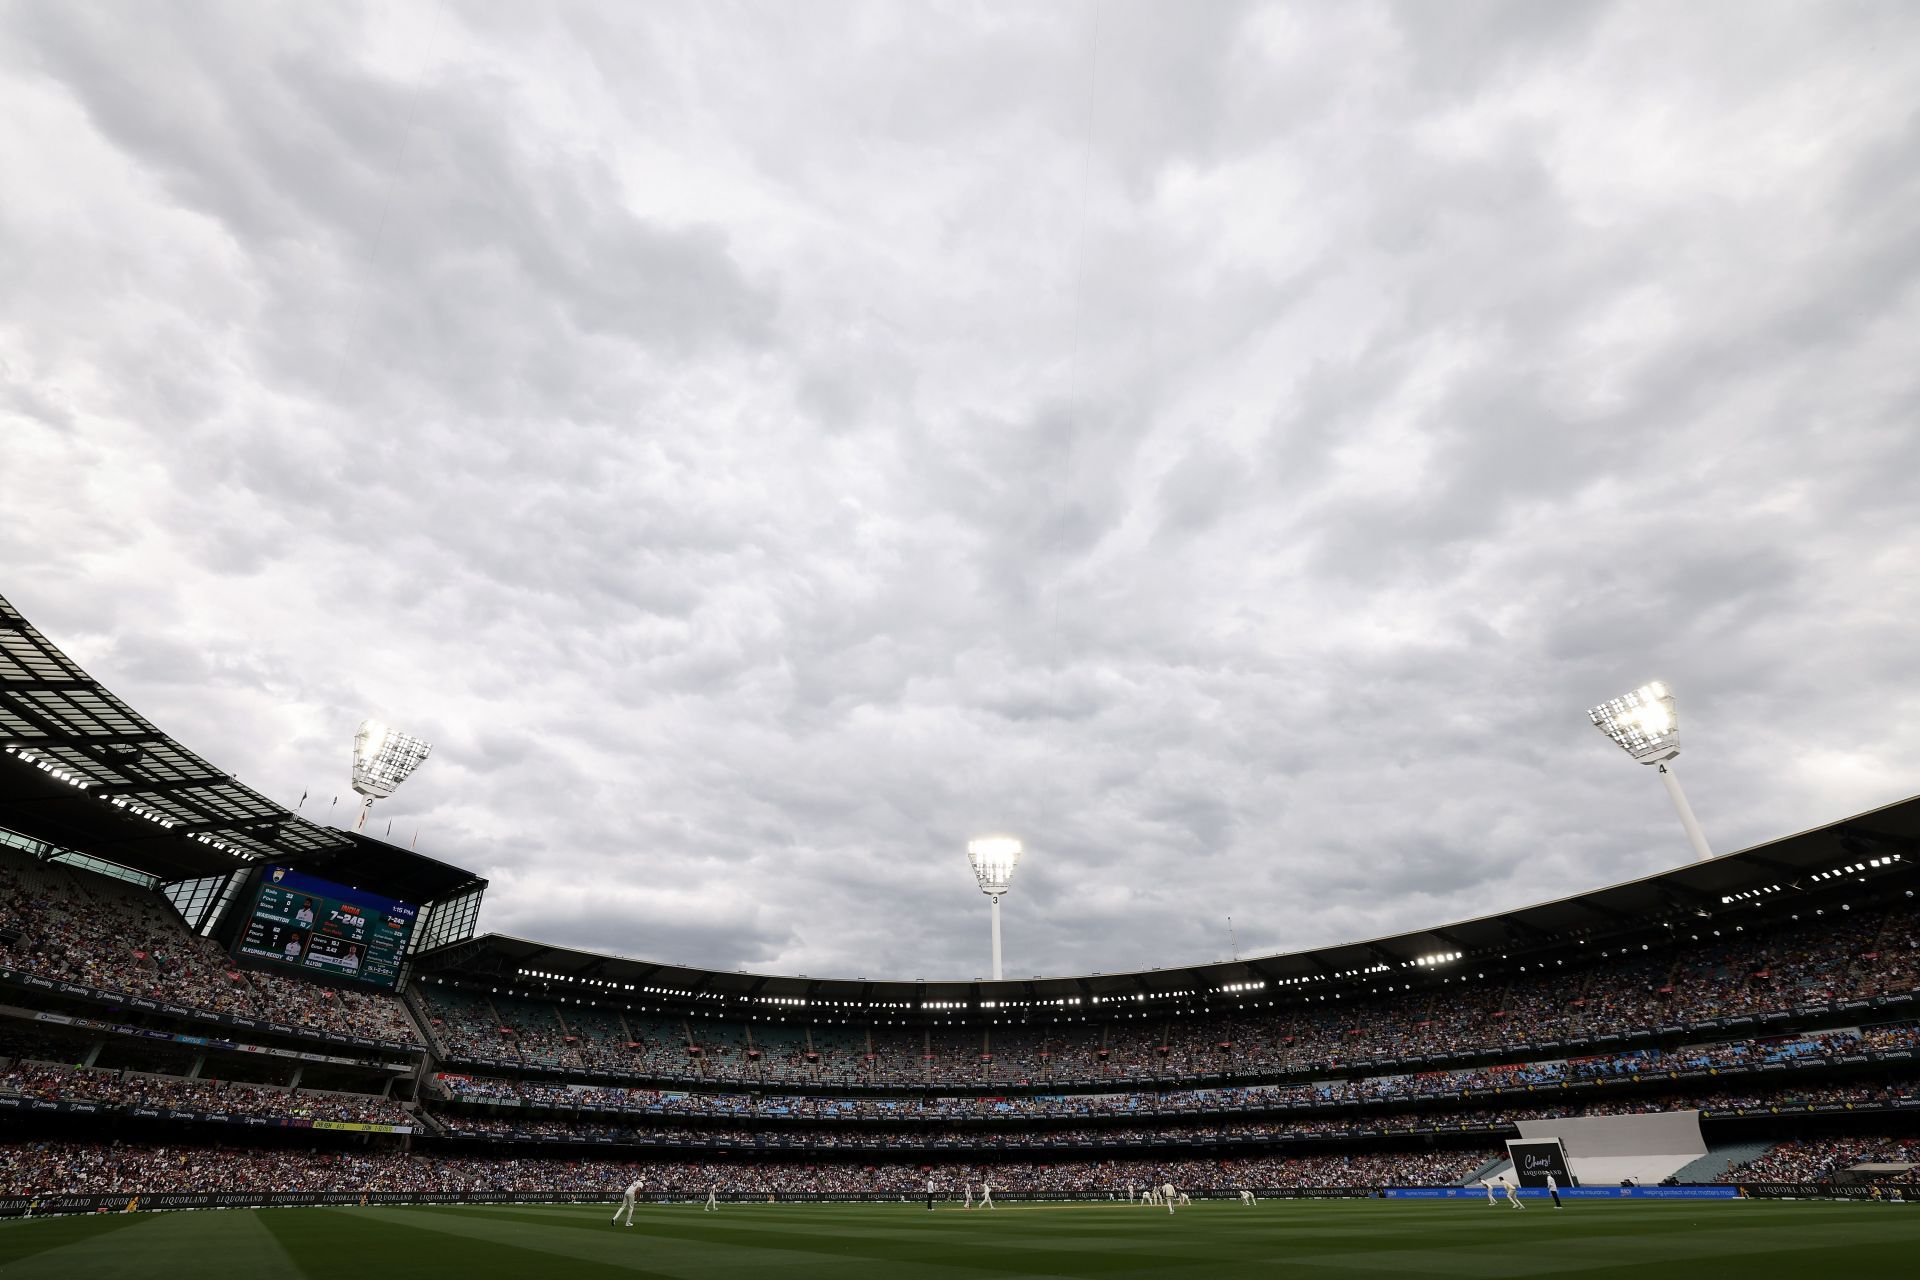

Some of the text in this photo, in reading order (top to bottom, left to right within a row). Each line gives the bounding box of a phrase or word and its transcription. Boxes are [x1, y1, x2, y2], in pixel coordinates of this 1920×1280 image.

[1658, 763, 1667, 774] 4
[365, 798, 373, 808] 2
[992, 896, 998, 904] 3
[403, 907, 414, 916] PM
[256, 911, 290, 923] WASHINGTON
[329, 910, 365, 928] 7-249
[31, 978, 54, 988] Remitly
[1886, 994, 1913, 1002] Remitly
[1842, 1054, 1868, 1062] Remitly
[1885, 1050, 1912, 1059] Remitly
[1758, 1186, 1818, 1195] LIQUORLAND
[160, 1196, 209, 1205] LIQUORLAND
[216, 1195, 264, 1204] LIQUORLAND
[270, 1195, 316, 1203] LIQUORLAND
[370, 1194, 413, 1202] LIQUORLAND
